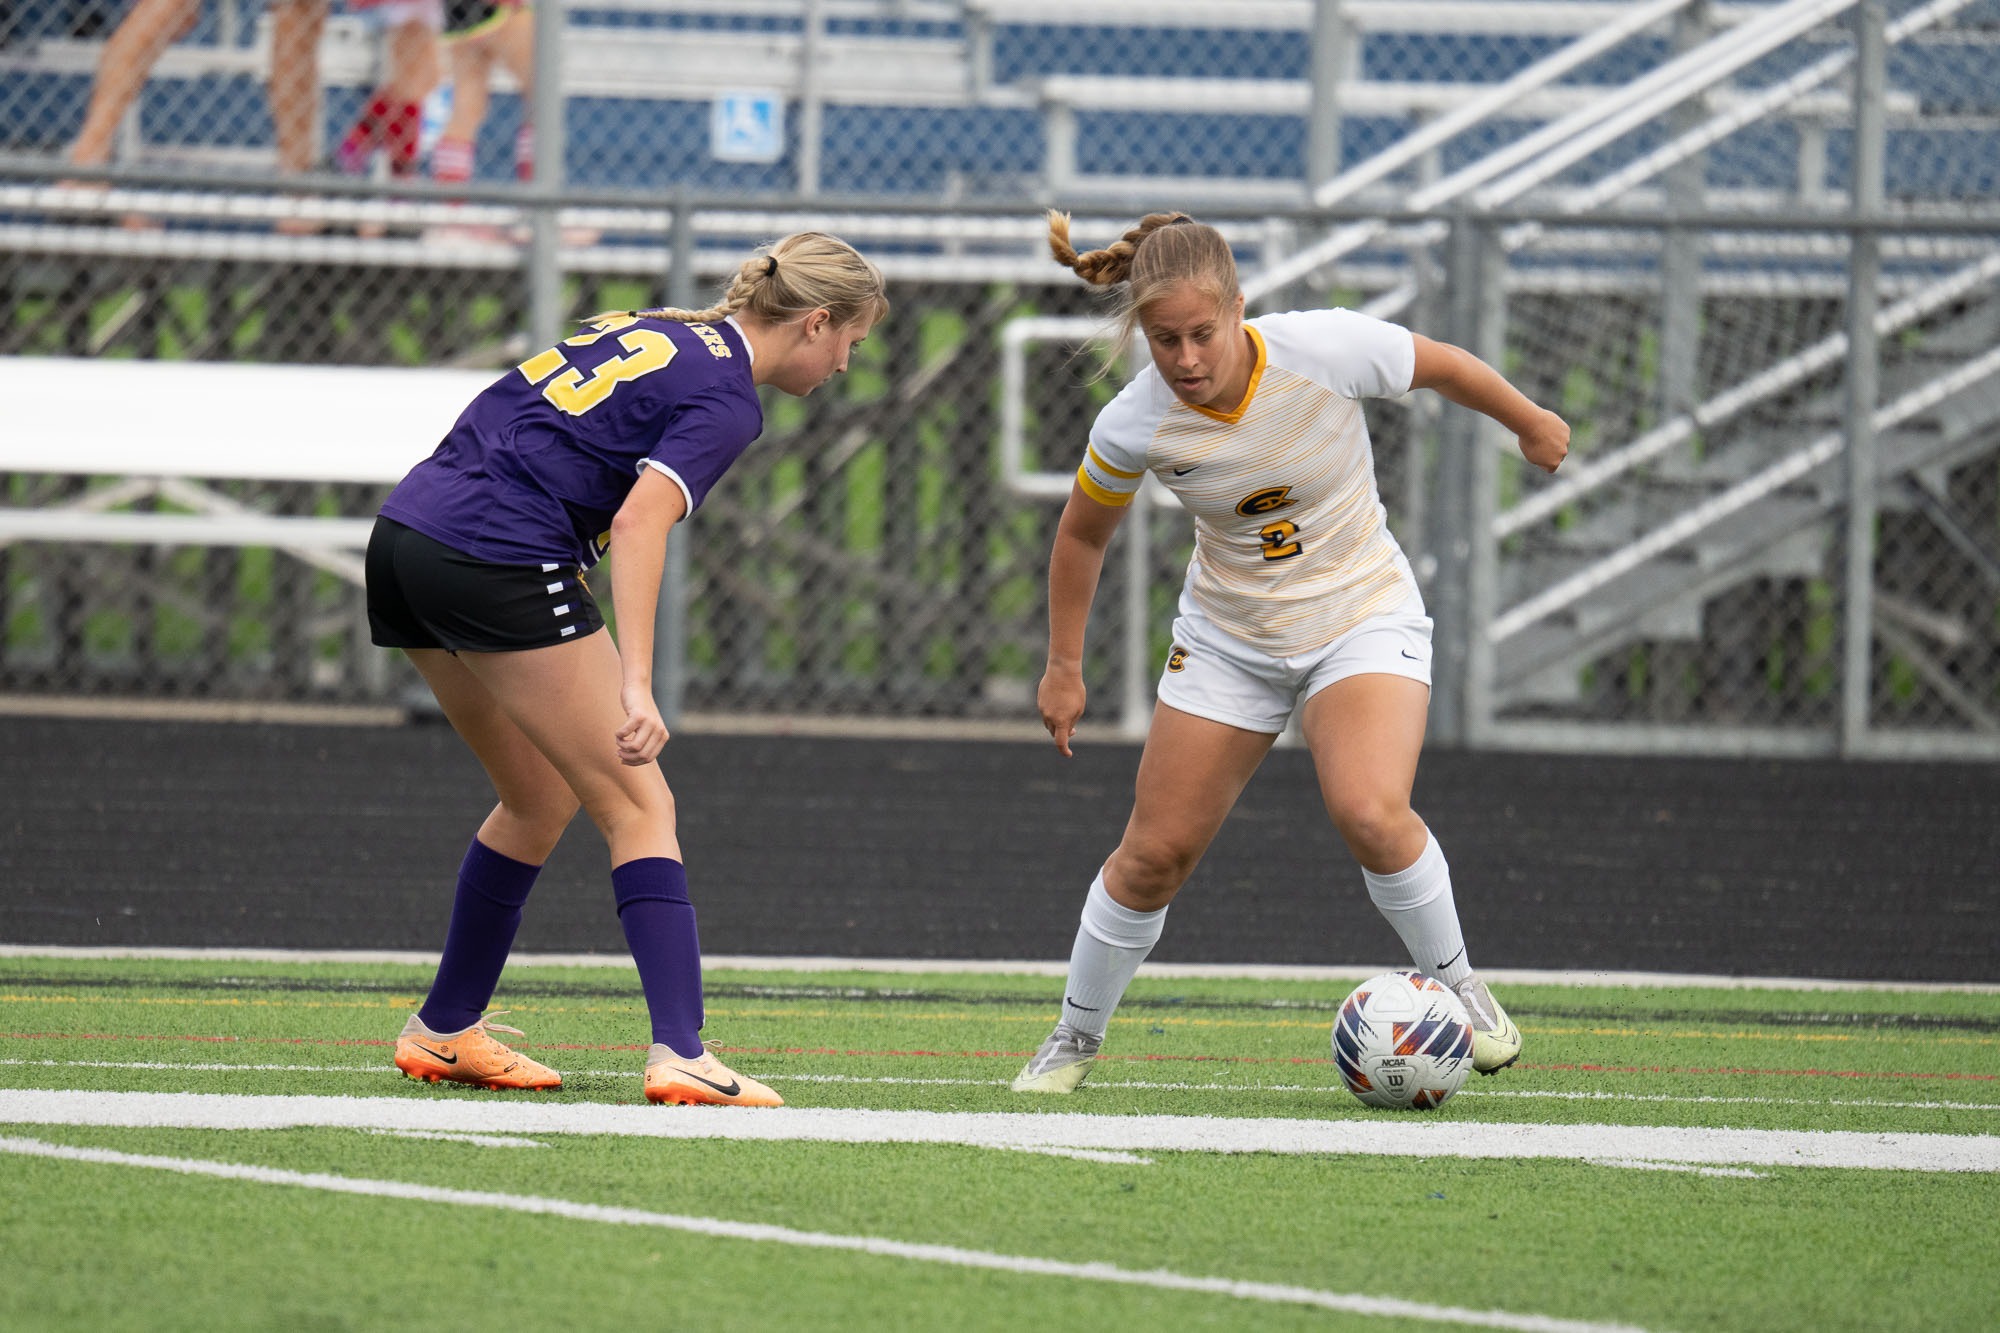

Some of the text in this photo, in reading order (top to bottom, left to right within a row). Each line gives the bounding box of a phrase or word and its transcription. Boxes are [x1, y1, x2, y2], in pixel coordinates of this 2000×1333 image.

[517, 314, 679, 417] 23
[1258, 519, 1303, 561] 2
[1381, 1058, 1406, 1067] NCAA
